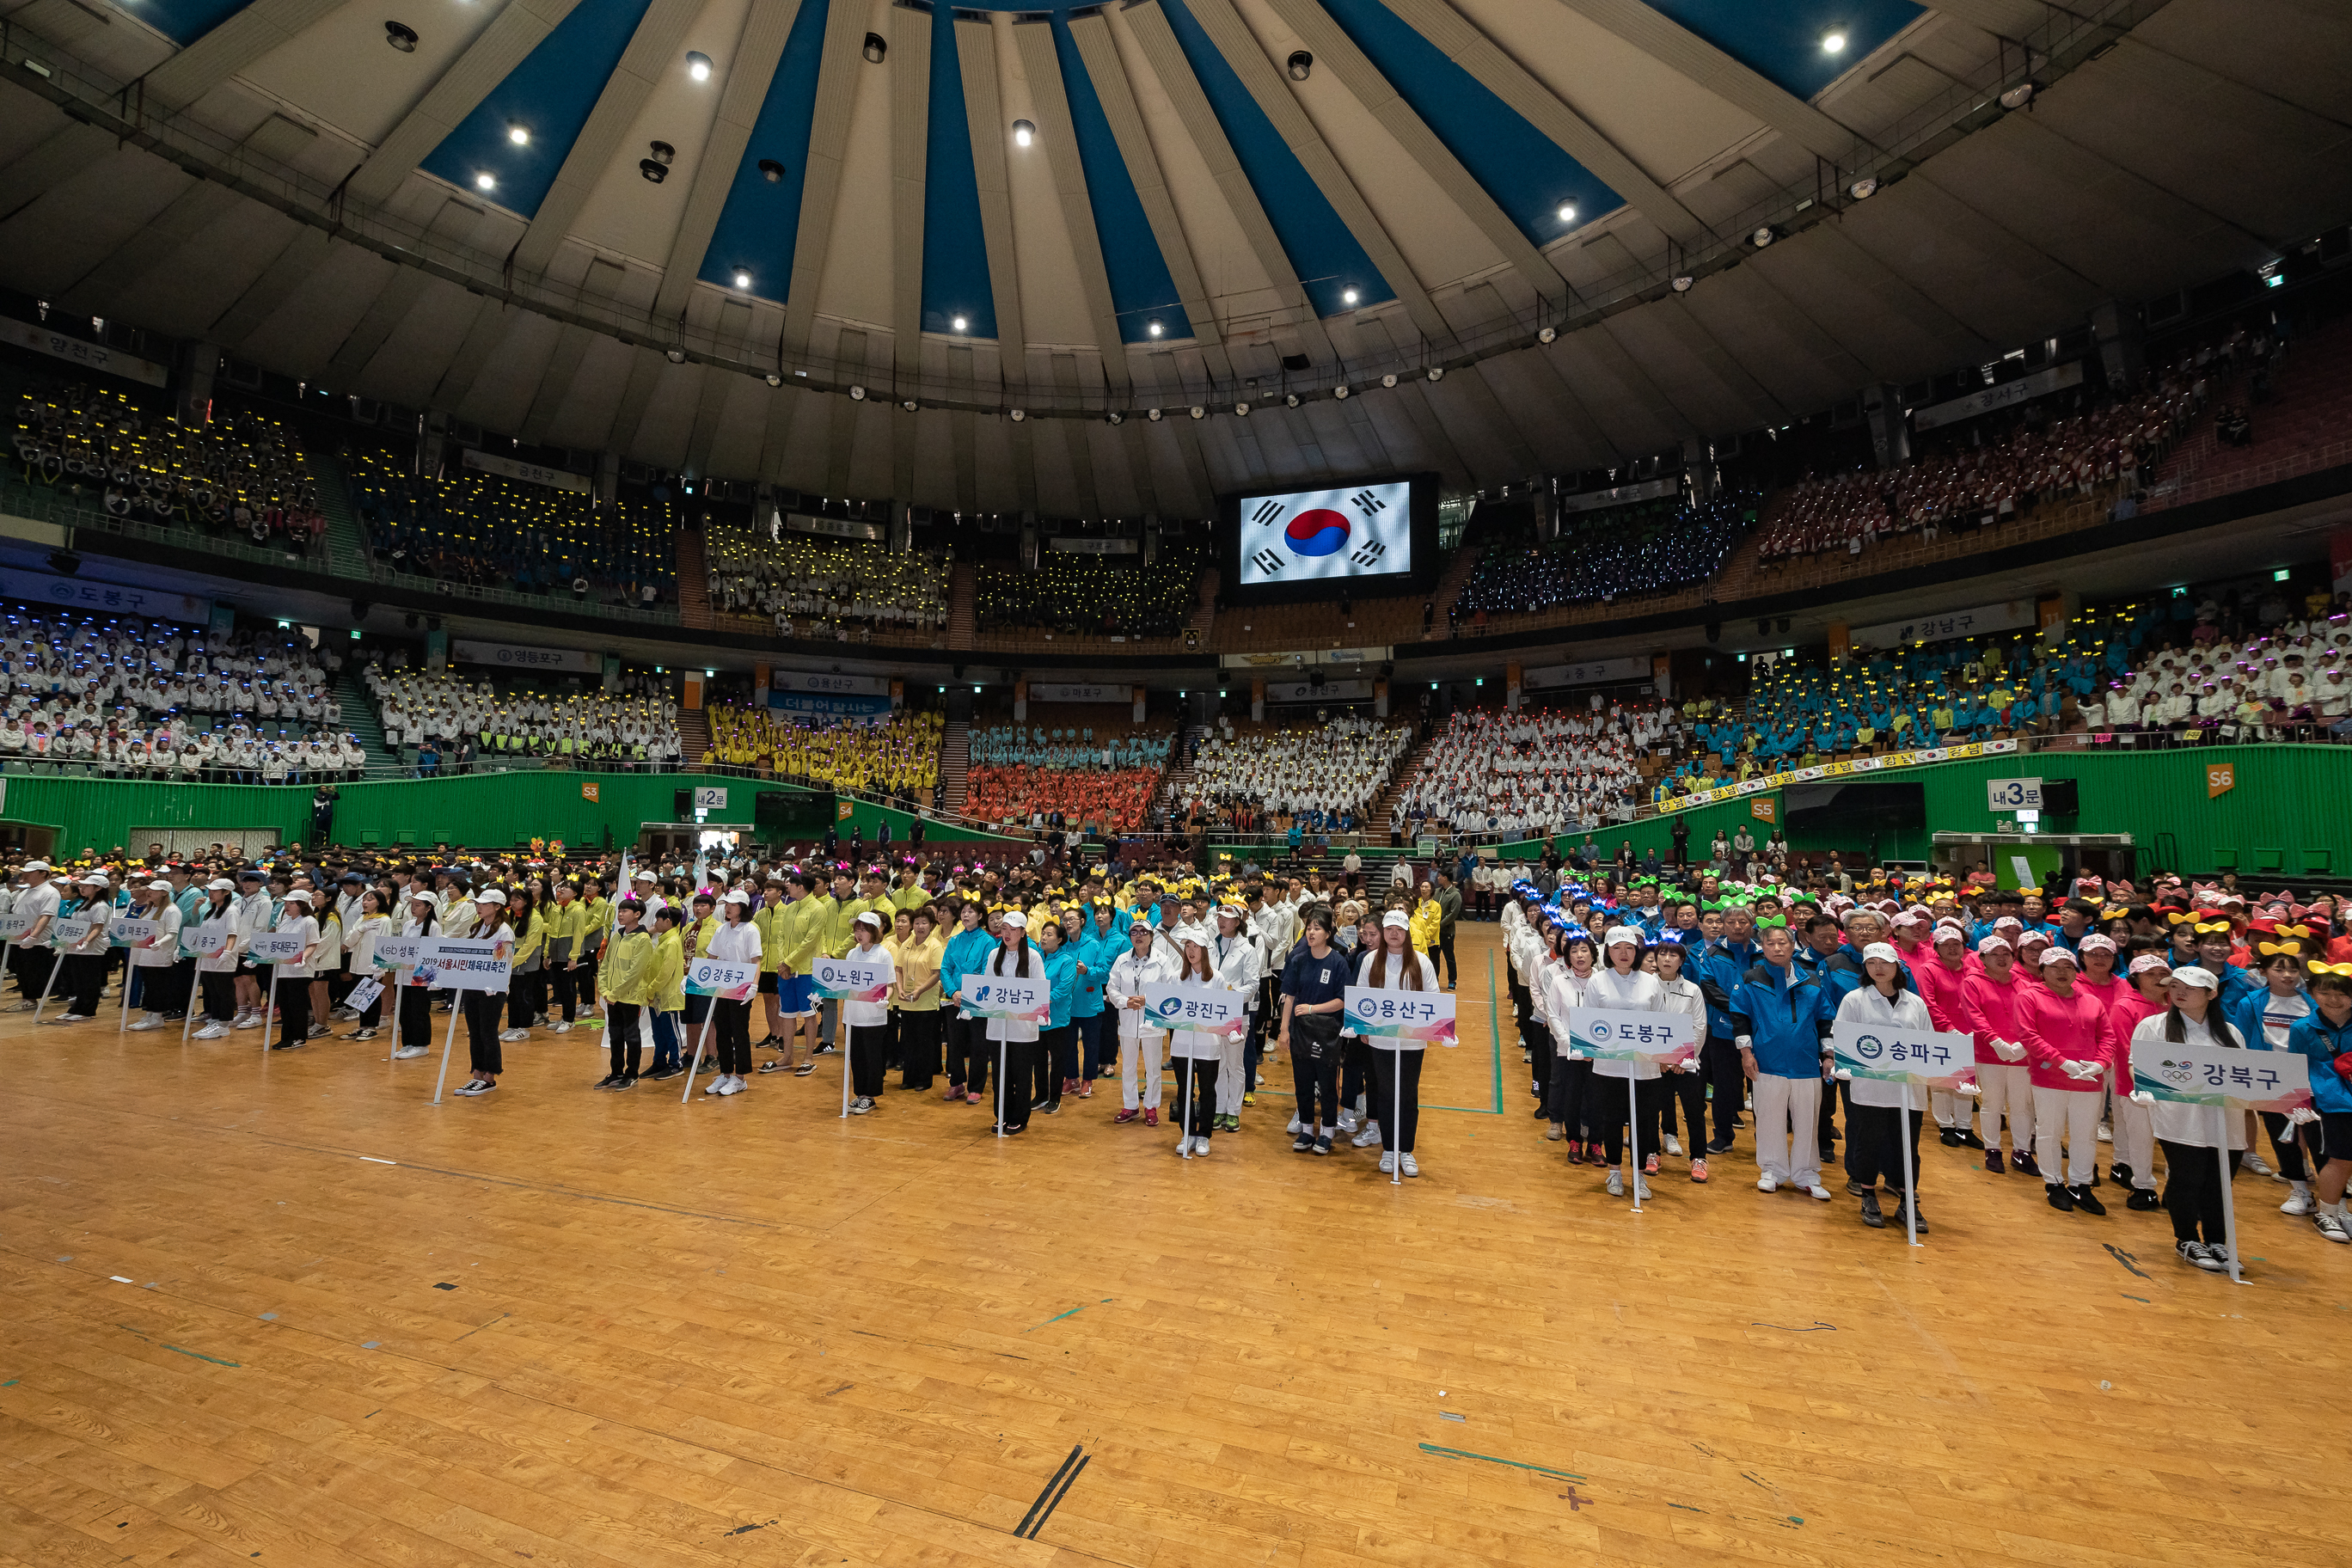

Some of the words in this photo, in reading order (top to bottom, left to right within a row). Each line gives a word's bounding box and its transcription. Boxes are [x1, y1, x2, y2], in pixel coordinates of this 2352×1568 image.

[51, 336, 108, 364] 양천구
[1981, 383, 2029, 407] 강서구
[519, 466, 555, 481] 금천구
[79, 587, 146, 609] 도봉구
[1921, 615, 1975, 637] 강남구
[515, 650, 563, 665] 영등포구
[1655, 666, 1668, 677] 10
[758, 678, 766, 688] 7
[820, 677, 854, 689] 용산구
[1309, 684, 1339, 695] 광진구
[894, 688, 901, 696] 7
[1072, 688, 1101, 698] 마포구
[785, 698, 830, 710] 더불어
[832, 701, 875, 713] 잘사는
[1949, 744, 1981, 757] 강남
[1825, 761, 1853, 775] 강남
[1766, 772, 1793, 786] 강남
[2209, 770, 2233, 787] S6
[584, 787, 597, 797] S3
[697, 790, 725, 805] 내2문
[1712, 785, 1737, 799] 강남
[1993, 782, 2040, 805] 내3문
[840, 806, 852, 816] S4
[1660, 797, 1684, 812] 강남
[1754, 804, 1773, 816] S5
[6, 920, 25, 929] 동작구
[127, 926, 150, 936] 마포구
[201, 936, 217, 947] 중구
[270, 941, 298, 952] 동대문구
[713, 968, 745, 983] 강동구
[836, 969, 874, 987] 노원구
[995, 988, 1035, 1005] 강남구
[1185, 1000, 1228, 1020] 광진구
[1380, 999, 1436, 1021] 용산구
[1618, 1023, 1675, 1044] 도봉구
[1889, 1040, 1952, 1066] 송파구
[2202, 1063, 2281, 1091] 강북구
